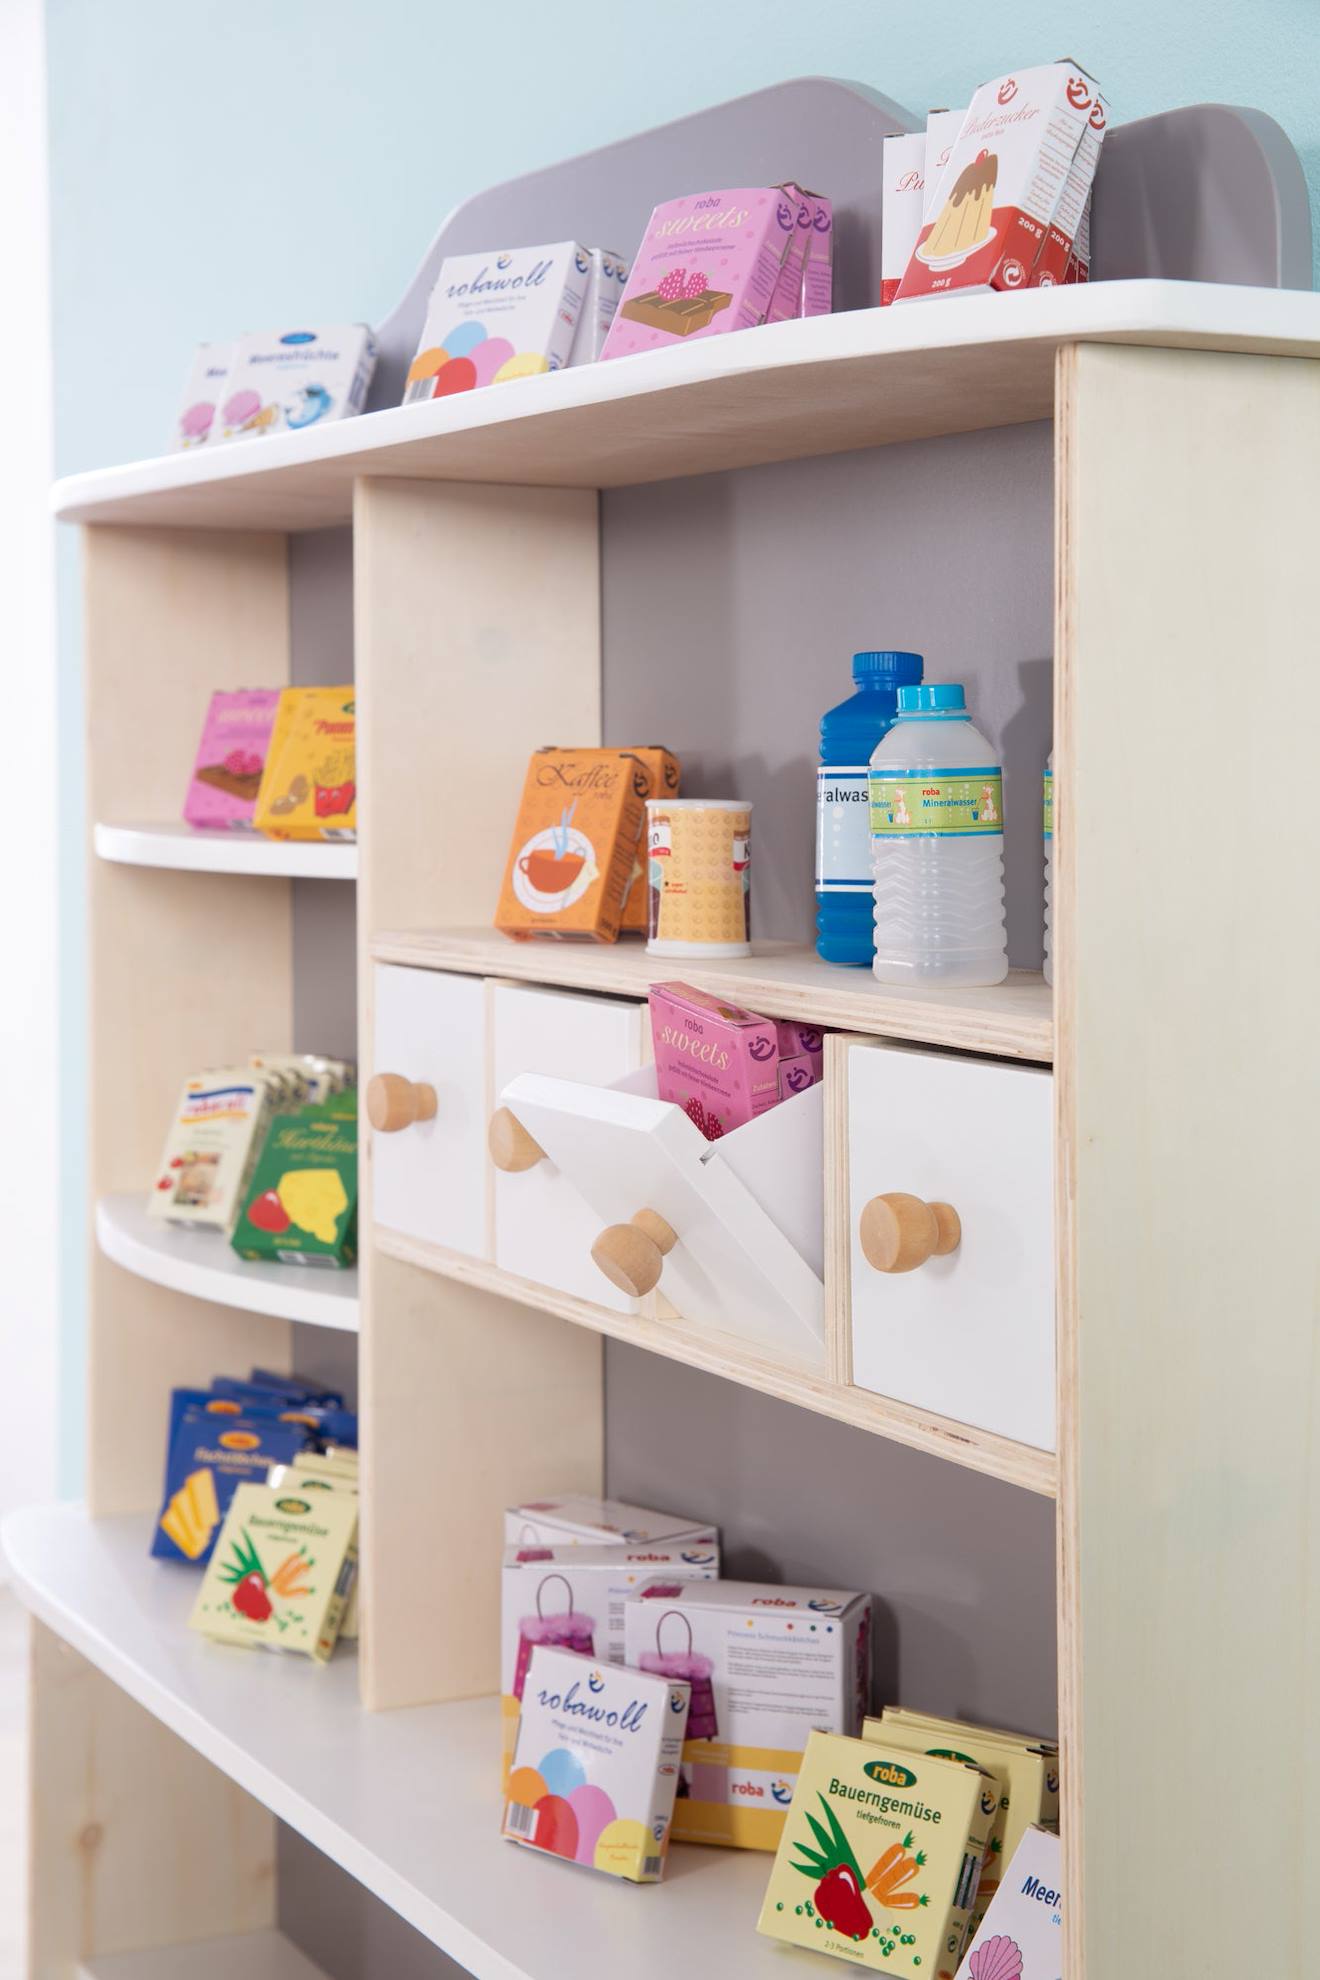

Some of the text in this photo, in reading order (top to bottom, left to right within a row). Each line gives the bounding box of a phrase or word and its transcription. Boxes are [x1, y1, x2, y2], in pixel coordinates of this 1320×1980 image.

[694, 196, 721, 209] roba
[655, 206, 749, 238] sweets
[1018, 217, 1036, 232] 200
[1050, 231, 1065, 246] 200
[446, 260, 553, 299] robawoll
[536, 764, 619, 797] Kaffee
[922, 788, 940, 796] roba
[922, 799, 977, 808] Mineralwasser
[684, 1018, 704, 1035] roba
[662, 1025, 729, 1071] sweets
[626, 1553, 671, 1562] roba
[751, 1597, 797, 1608] roba
[537, 1681, 648, 1733] robawoll
[873, 1765, 907, 1786] roba
[731, 1781, 765, 1798] roba
[828, 1778, 943, 1825] Bauerngemüse
[856, 1810, 902, 1831] tiefgefroren
